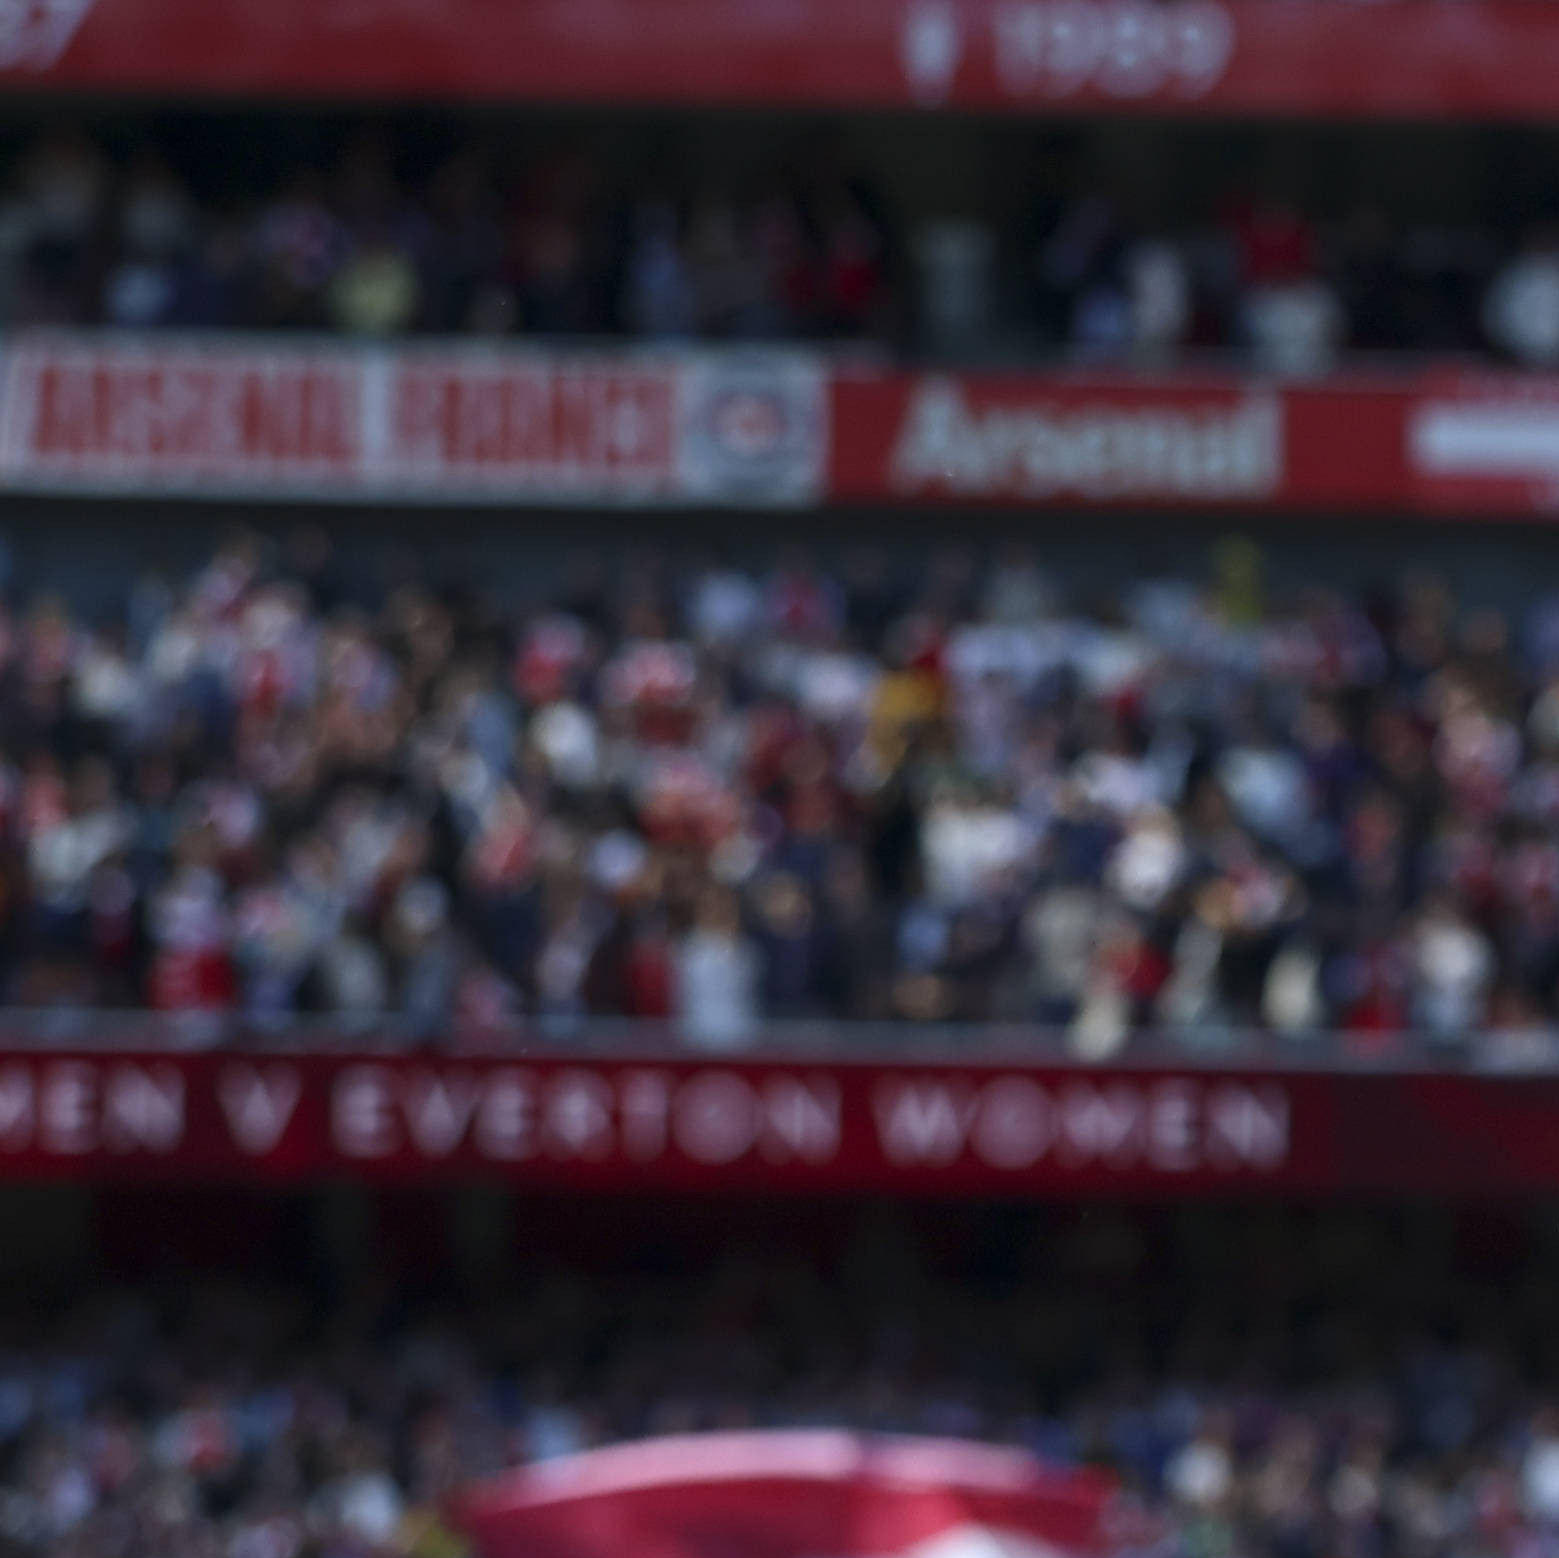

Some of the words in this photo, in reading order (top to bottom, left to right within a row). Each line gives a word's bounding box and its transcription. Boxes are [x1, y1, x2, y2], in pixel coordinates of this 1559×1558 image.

[886, 376, 1280, 494] Arsenal
[332, 1065, 842, 1164] EVERTON
[870, 1074, 1290, 1171] WOMEN
